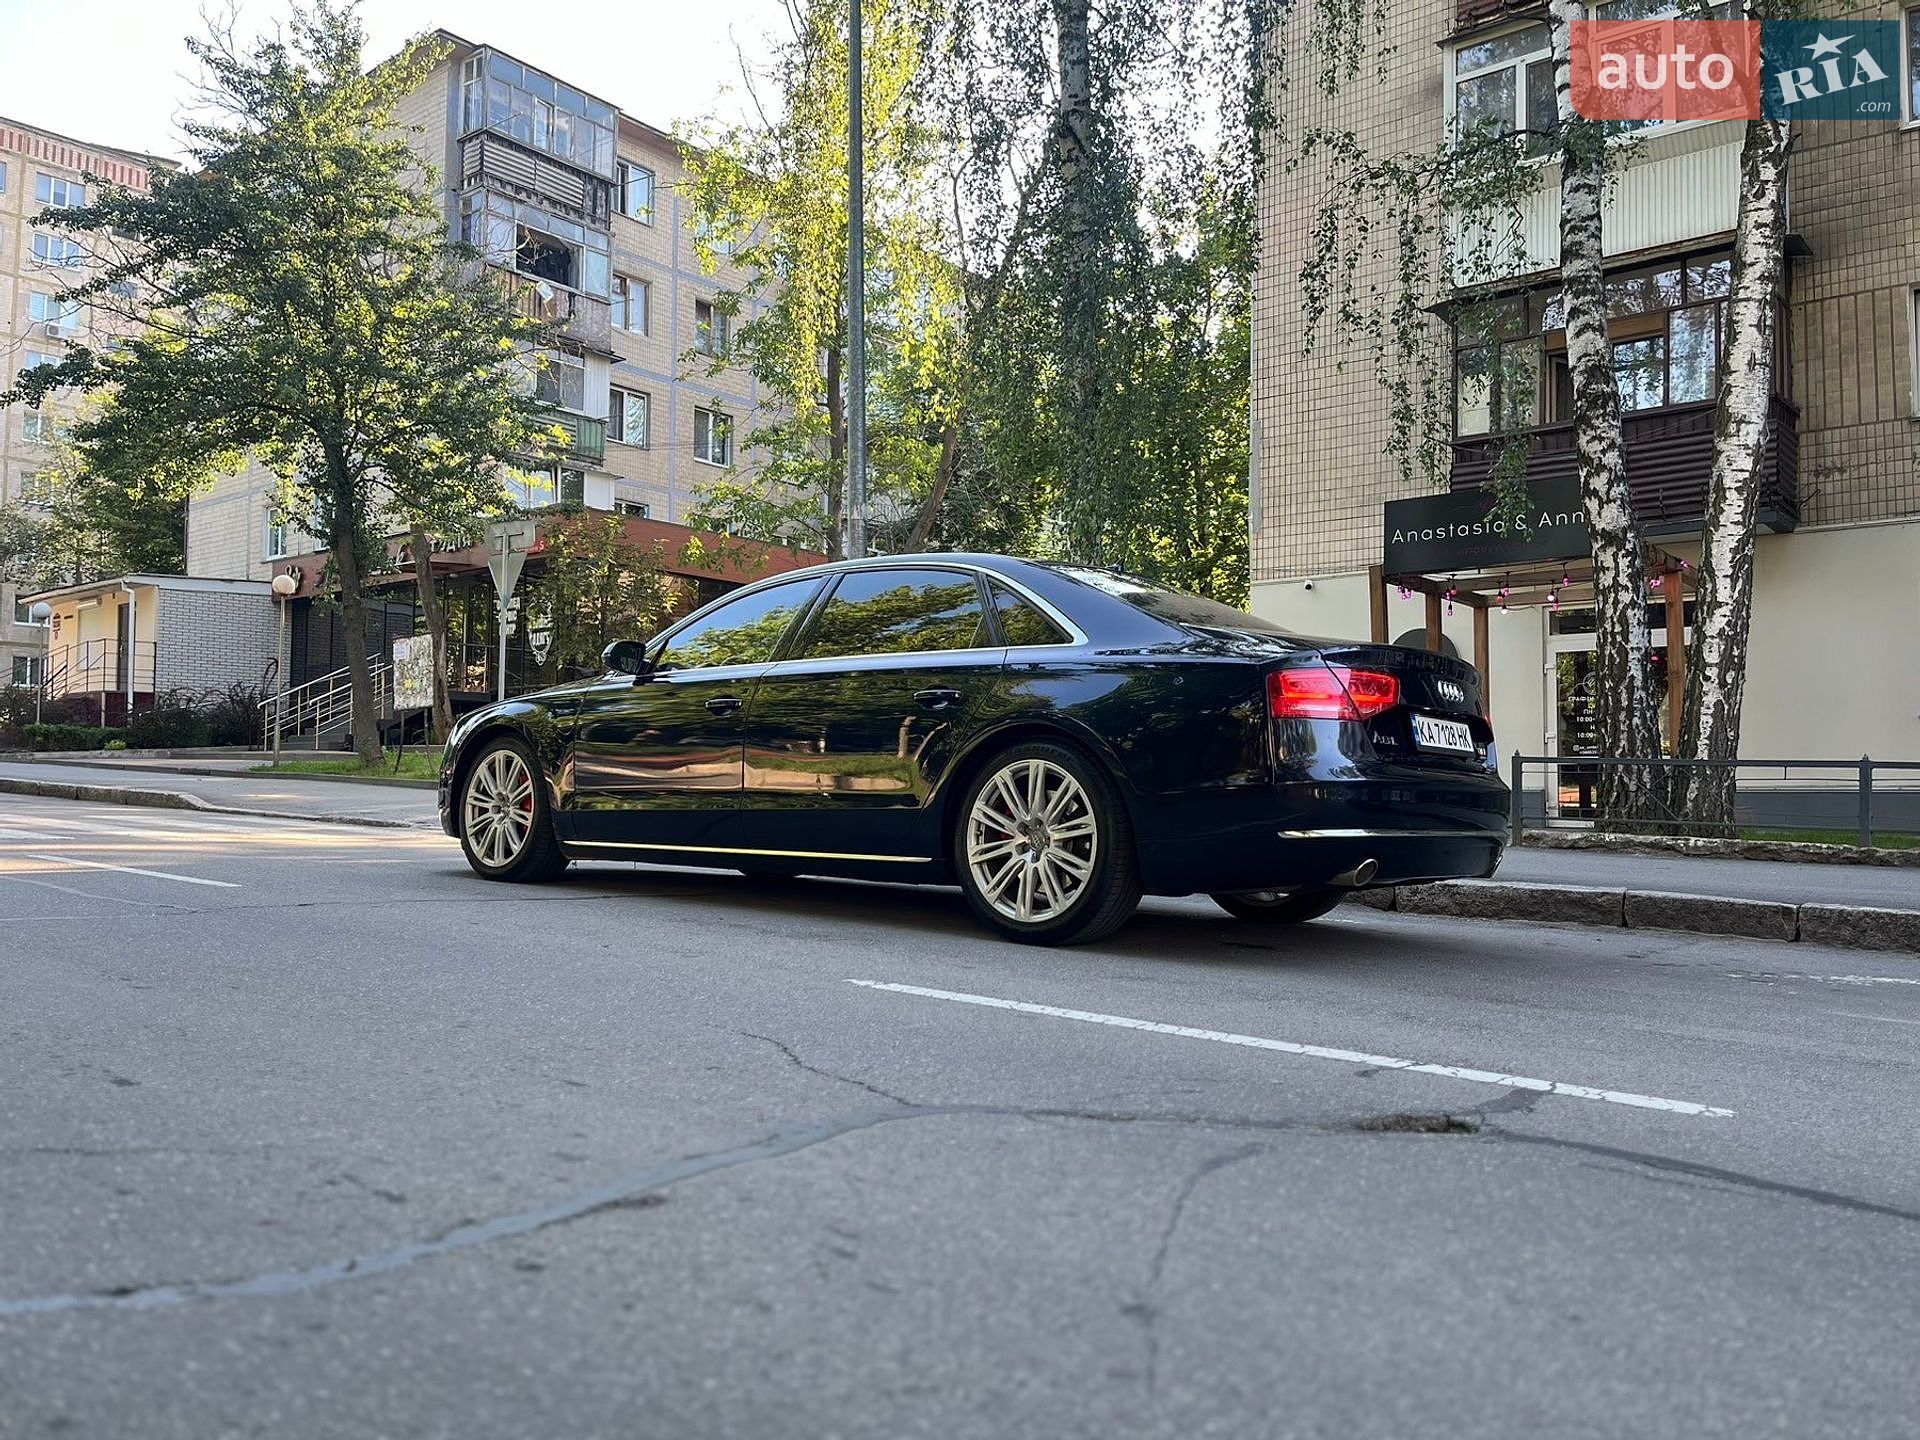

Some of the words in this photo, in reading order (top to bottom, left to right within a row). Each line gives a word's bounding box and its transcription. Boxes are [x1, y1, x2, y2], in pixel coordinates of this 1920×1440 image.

[1391, 519, 1505, 544] Anastasia
[1514, 514, 1528, 530] &
[1538, 510, 1585, 529] Ann
[1417, 720, 1435, 744] KA
[1433, 723, 1458, 746] 7128
[1456, 726, 1472, 749] HK
